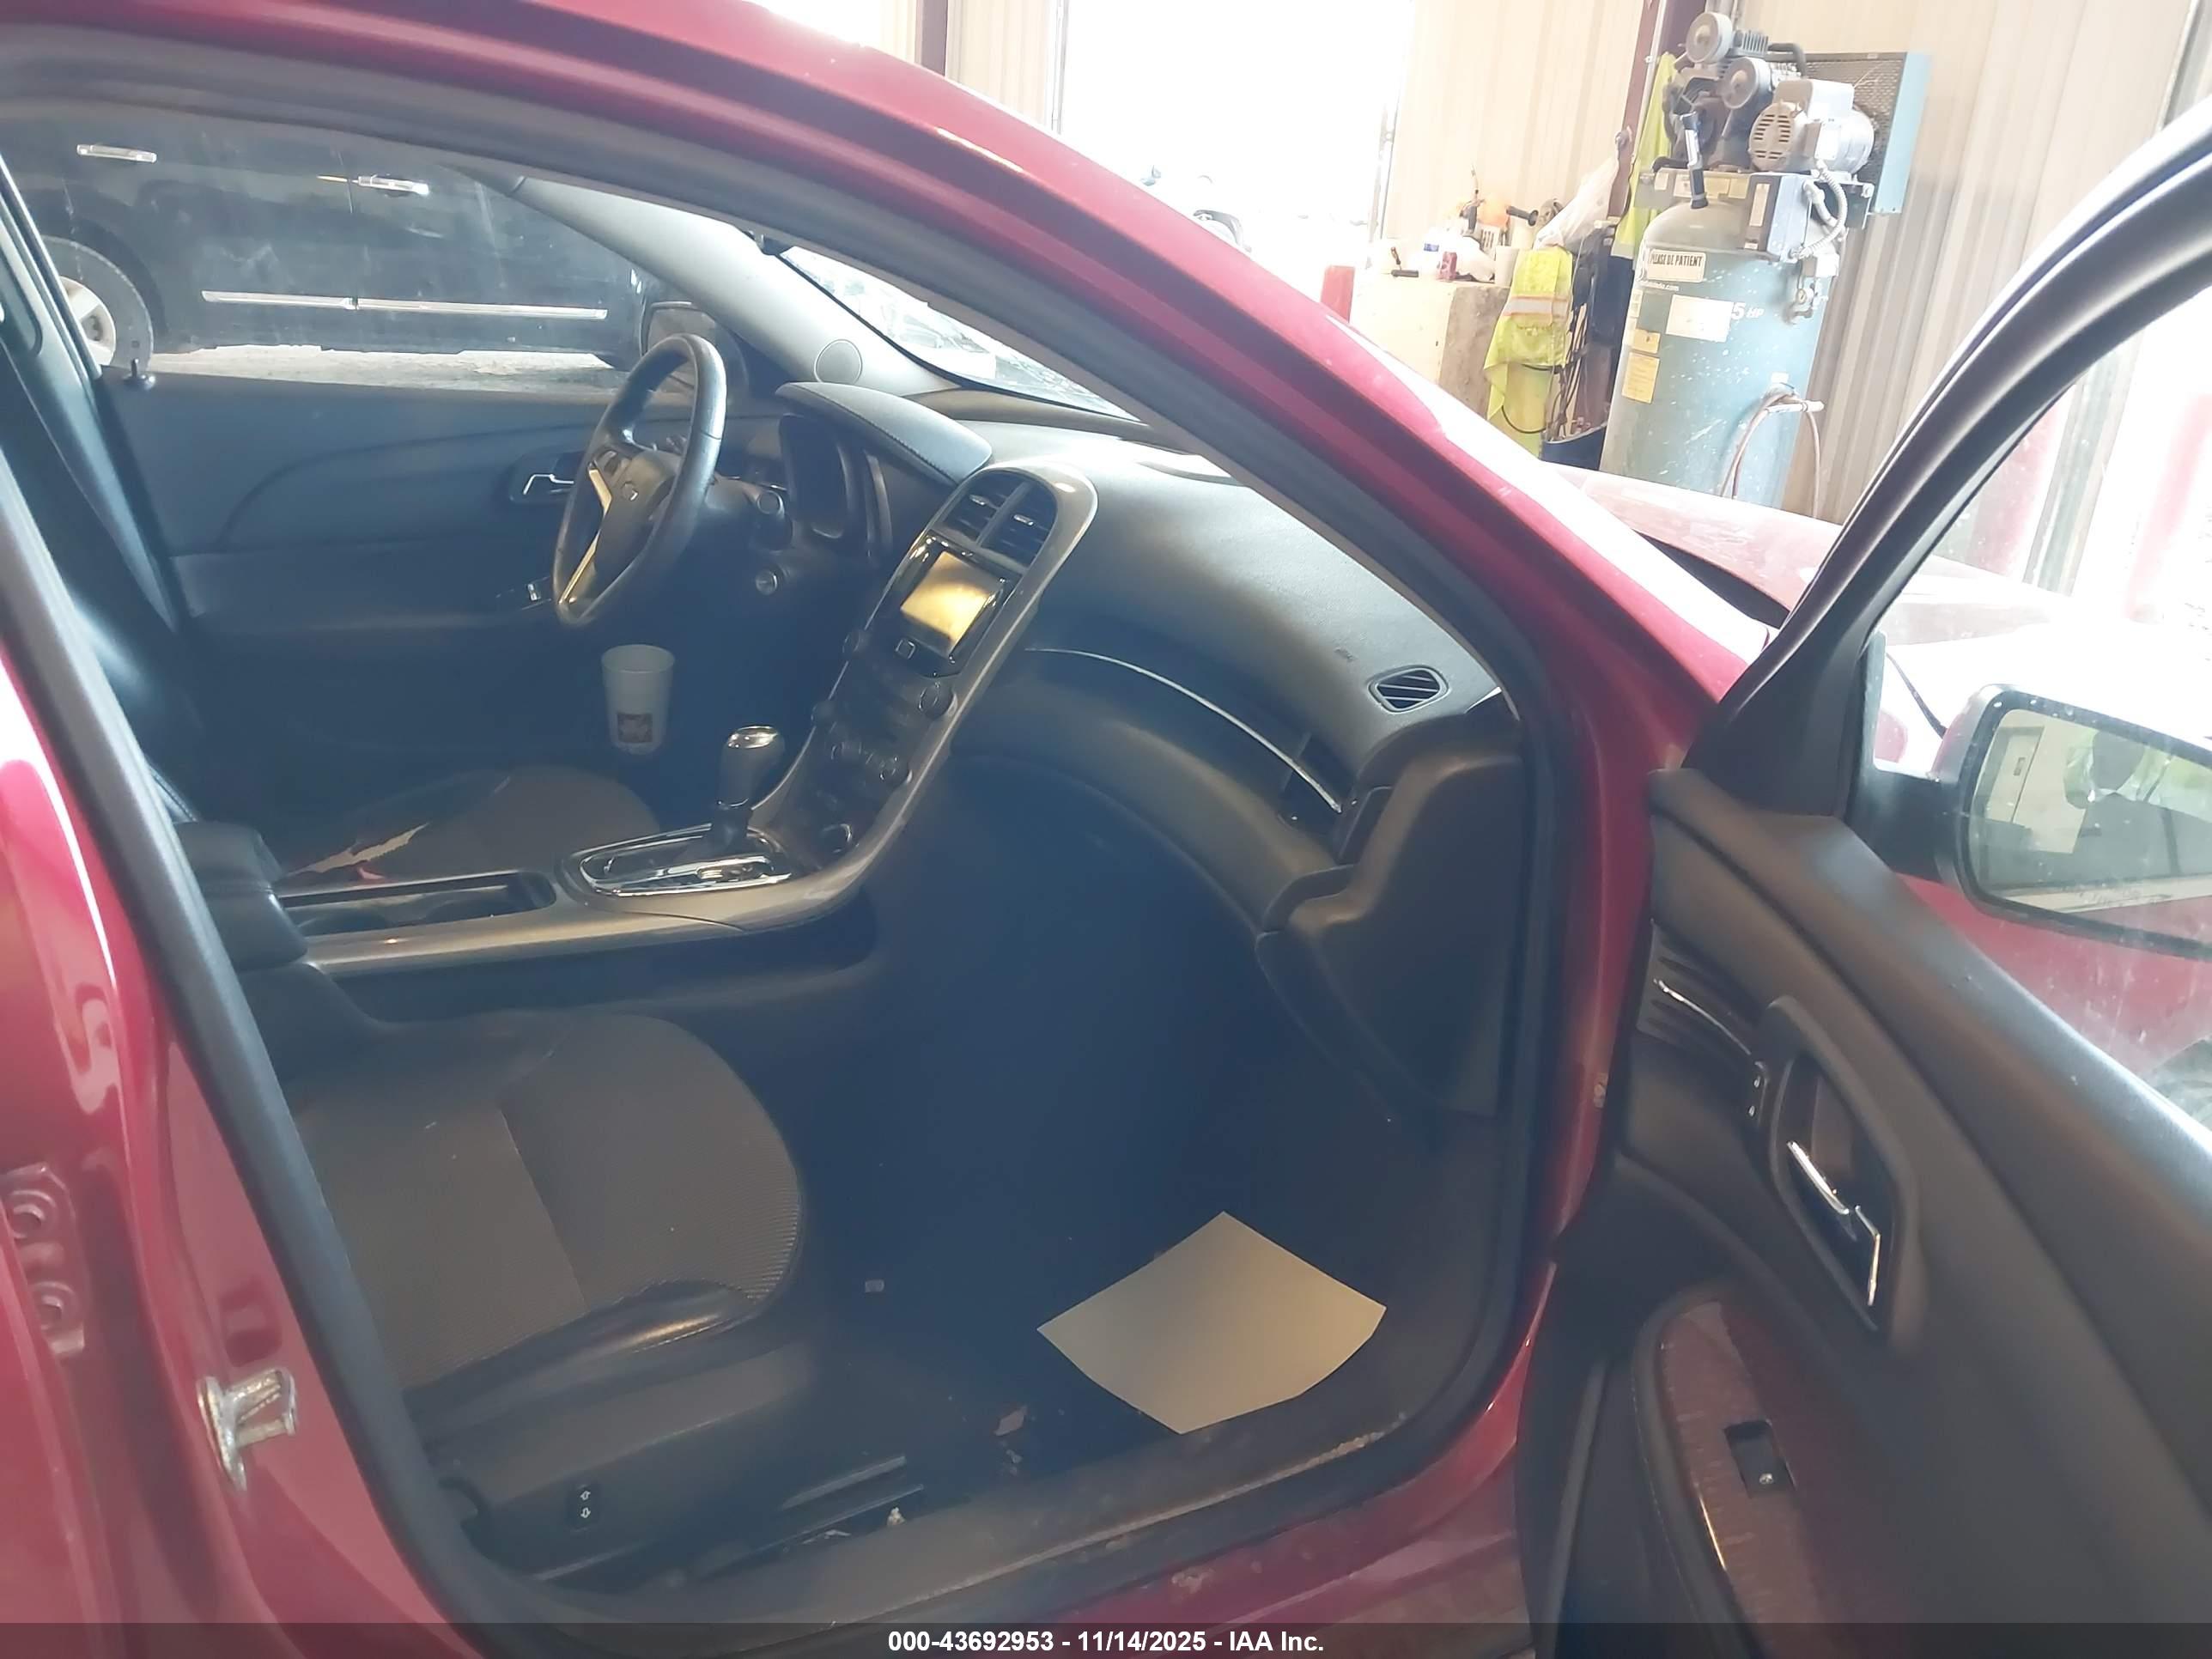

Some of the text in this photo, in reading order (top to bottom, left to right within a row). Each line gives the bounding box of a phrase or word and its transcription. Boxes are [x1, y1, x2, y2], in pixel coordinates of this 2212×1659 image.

[1675, 254, 1703, 267] PATIENT
[1731, 301, 1765, 320] 5 HP
